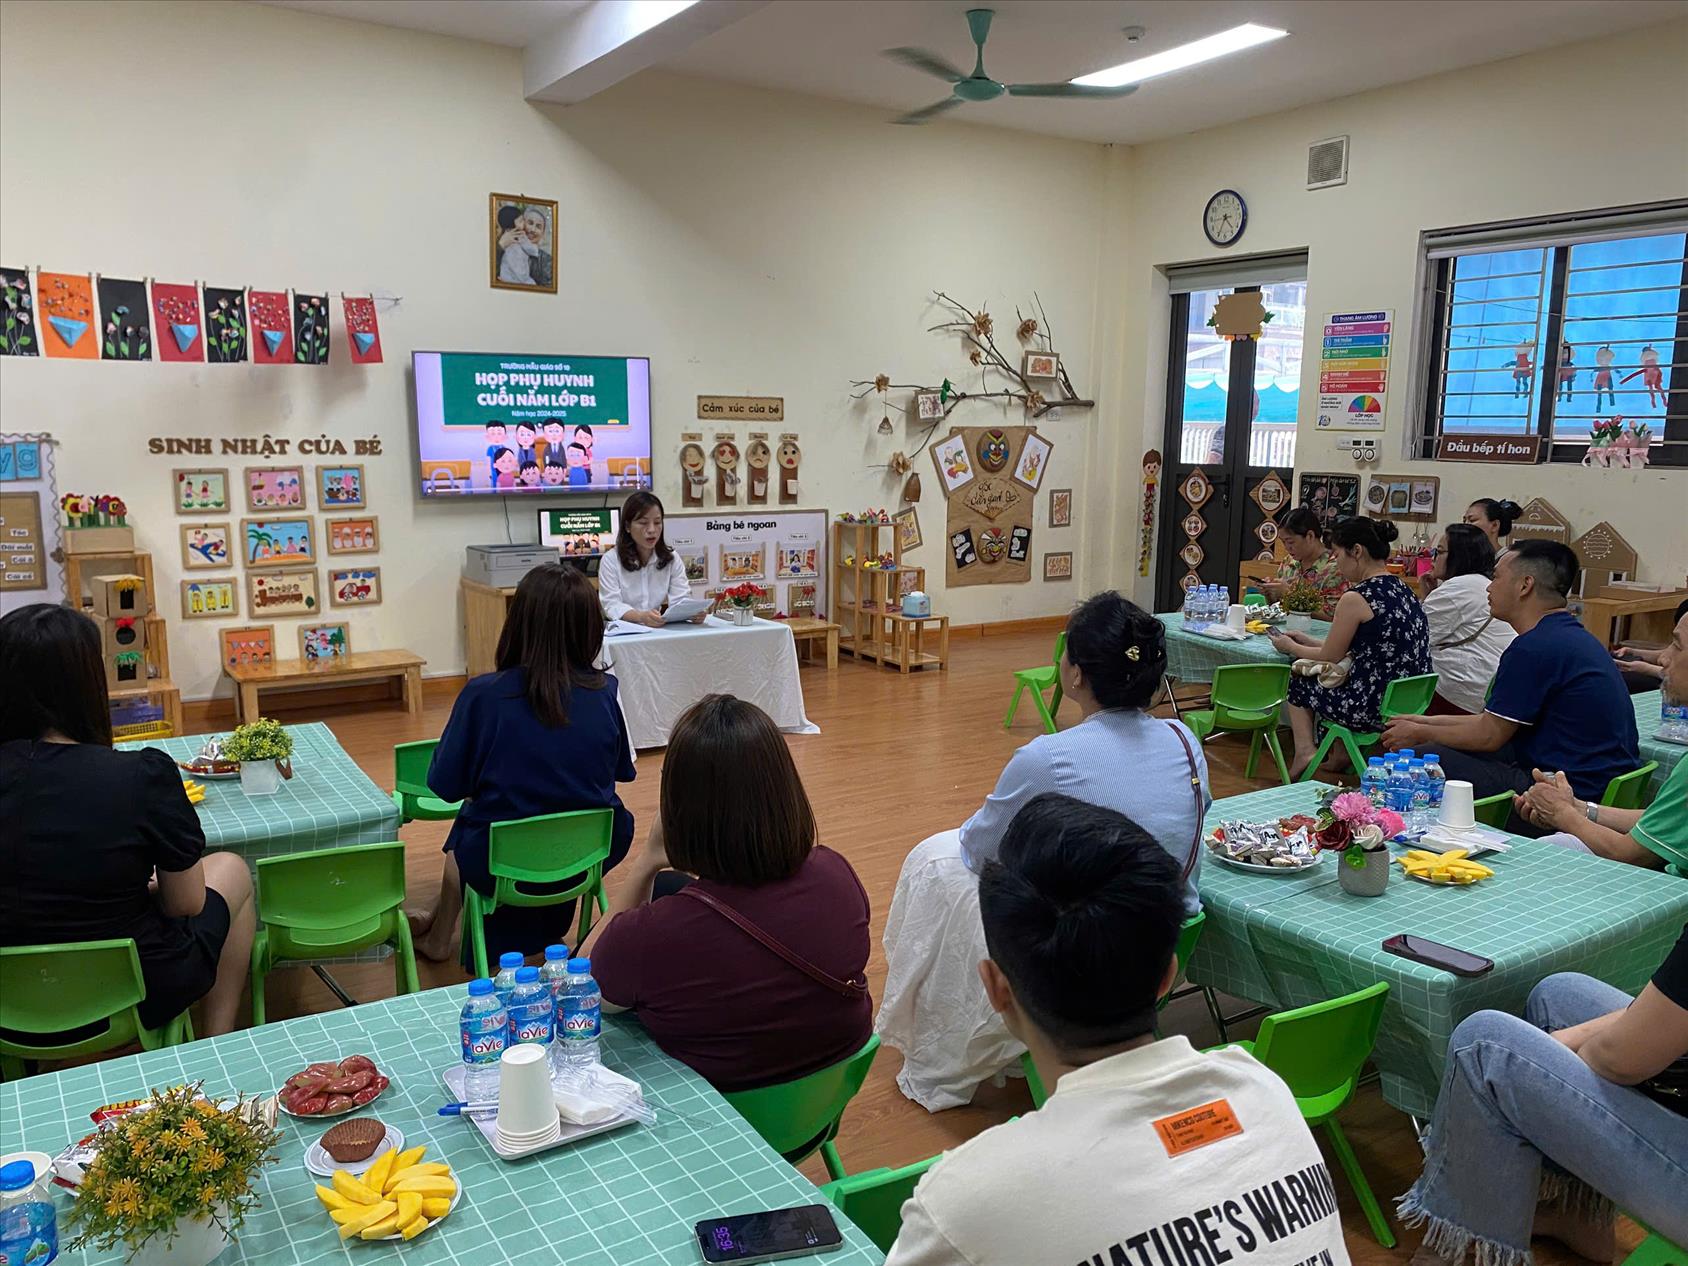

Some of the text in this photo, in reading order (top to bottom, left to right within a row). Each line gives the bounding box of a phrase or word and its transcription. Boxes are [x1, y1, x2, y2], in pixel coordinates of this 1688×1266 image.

[475, 372, 594, 390] HỌP PHỤ HUYNH
[476, 386, 597, 407] CUỐI NĂM LỚP B1
[702, 402, 779, 414] Cảm xúc của bé
[148, 434, 383, 459] SINH NHẬT CỦA BÉ
[1447, 439, 1531, 456] Đầu bếp tí hon
[706, 520, 777, 532] Bảng bé ngoan
[1077, 1162, 1337, 1266] TURE'S WARNIN
